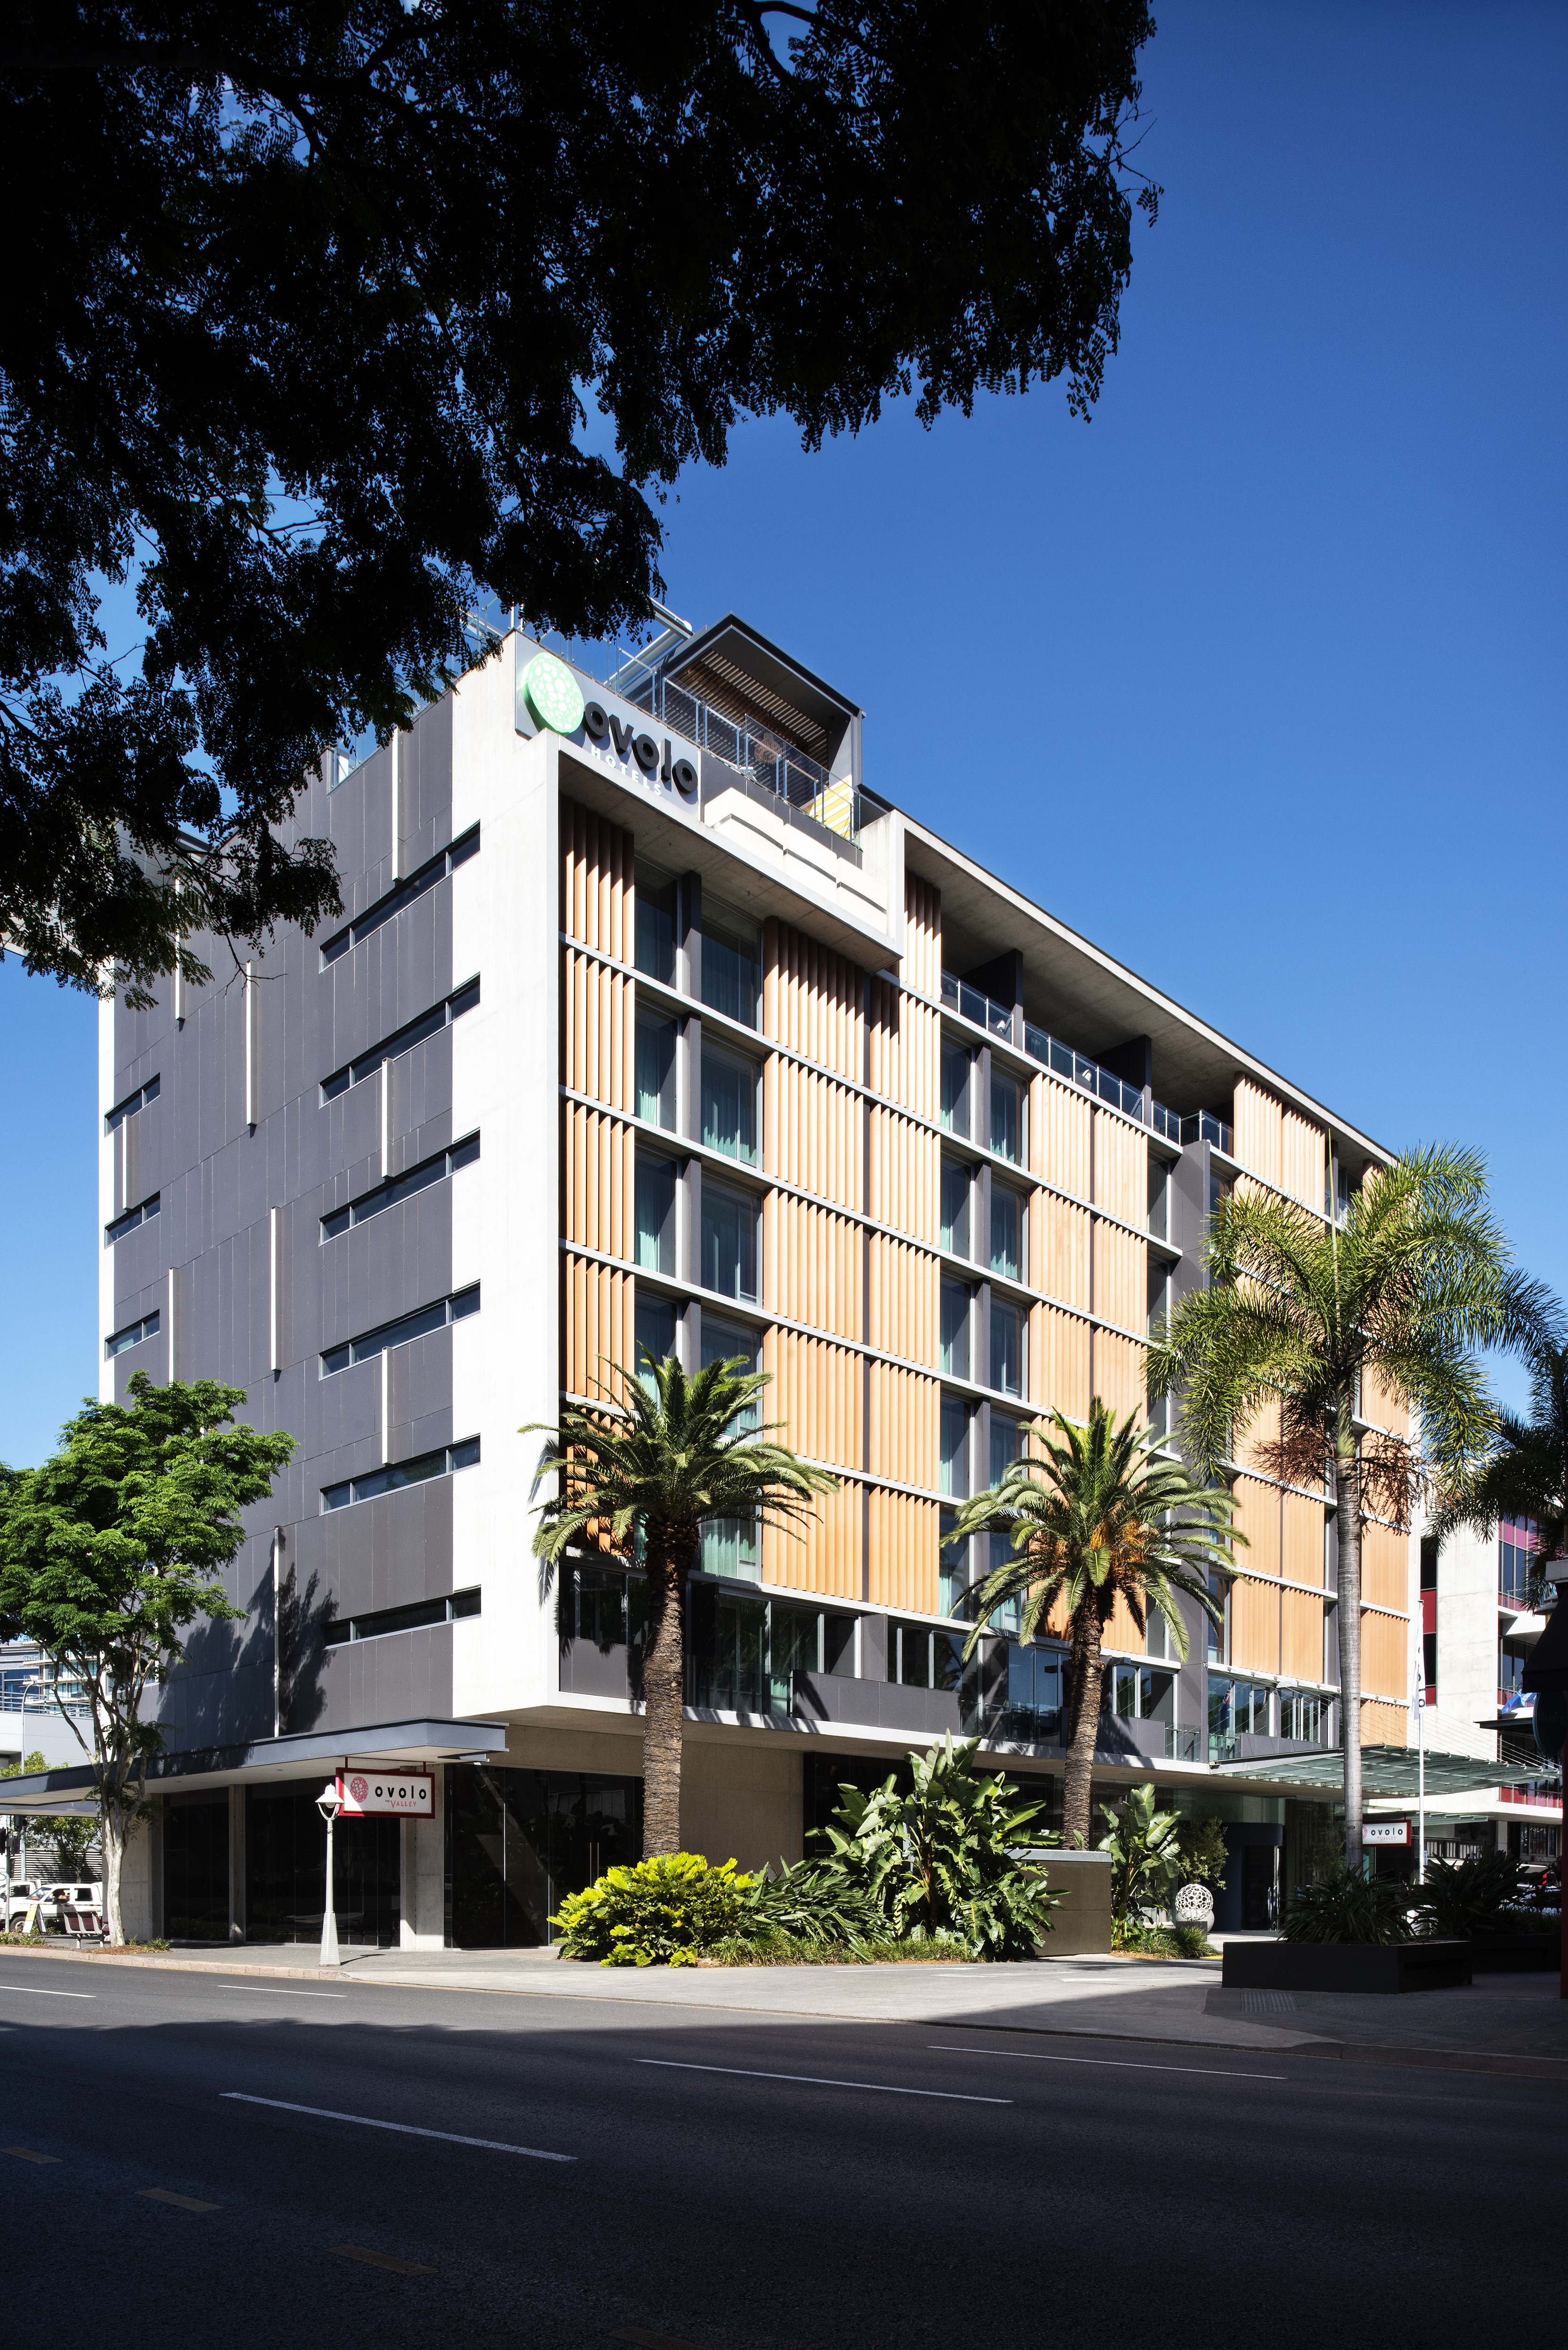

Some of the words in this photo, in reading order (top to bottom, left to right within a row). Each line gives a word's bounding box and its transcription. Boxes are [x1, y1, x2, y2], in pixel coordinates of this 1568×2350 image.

[584, 701, 698, 794] ovolo
[591, 745, 662, 797] HOTELS
[375, 1785, 427, 1800] ovolo
[390, 1800, 416, 1809] VALLEY
[1371, 1827, 1403, 1836] ovolo
